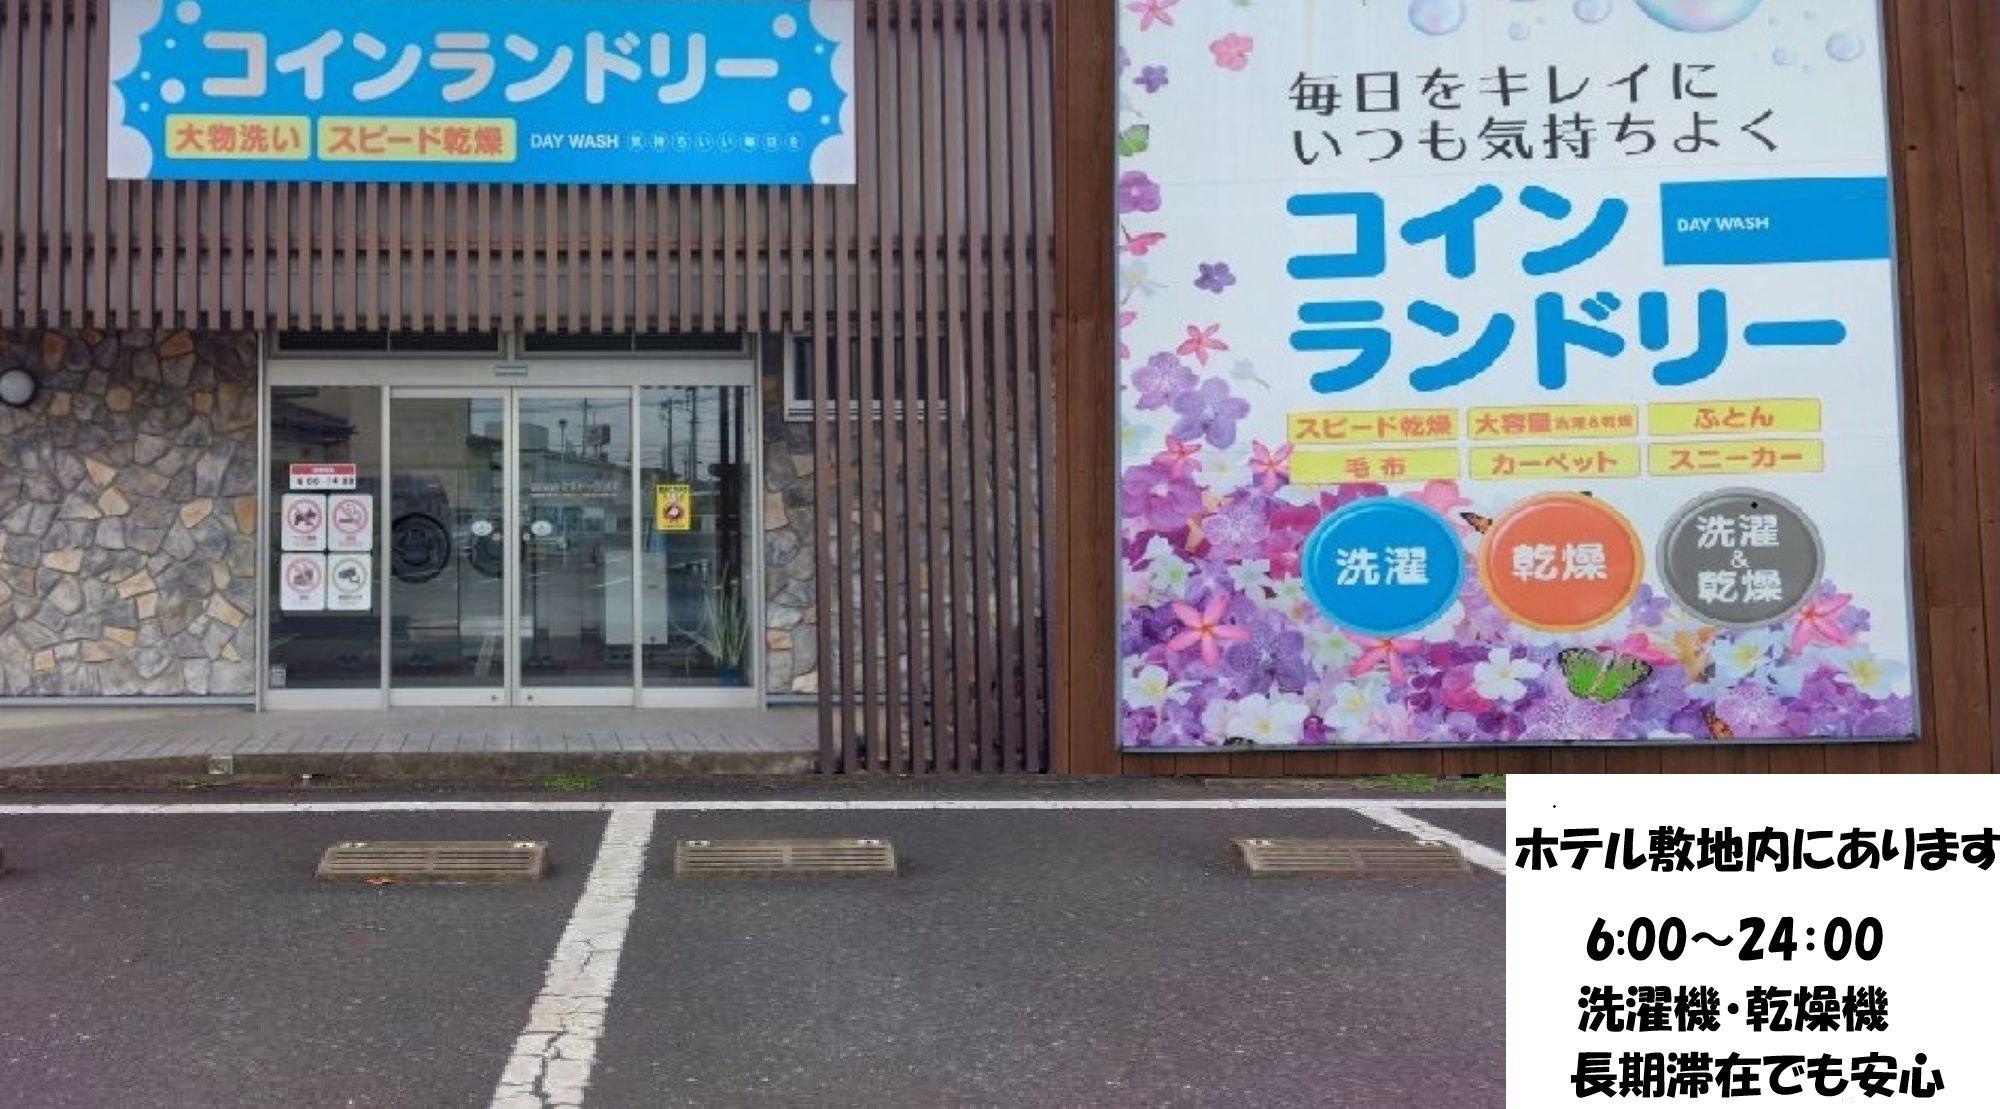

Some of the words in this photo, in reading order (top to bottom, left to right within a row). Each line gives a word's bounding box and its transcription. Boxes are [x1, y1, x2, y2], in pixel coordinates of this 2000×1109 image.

[203, 28, 779, 104] コインランドリー
[1289, 61, 1719, 114] 毎日をキレイに
[175, 122, 302, 155] 大物洗い
[326, 124, 506, 157] スピード乾燥
[531, 133, 564, 149] DAY
[567, 133, 619, 149] WASH
[1294, 107, 1780, 165] いつも気持ちよく
[1287, 184, 1628, 280] コイン
[1677, 216, 1711, 232] DAY
[1715, 215, 1769, 231] WASH
[1289, 288, 1847, 394] ランドリー
[1296, 414, 1451, 439] スピード乾燥
[1694, 405, 1774, 430] ふとん
[1345, 455, 1406, 478] 毛布
[1491, 450, 1618, 475] カーペット
[1669, 446, 1803, 471] スニーカー
[1696, 514, 1780, 550] 洗濯
[1335, 546, 1431, 587] 洗濯
[1511, 542, 1609, 582] 乾燥
[1730, 550, 1749, 568] &
[1697, 569, 1784, 605] 乾燥
